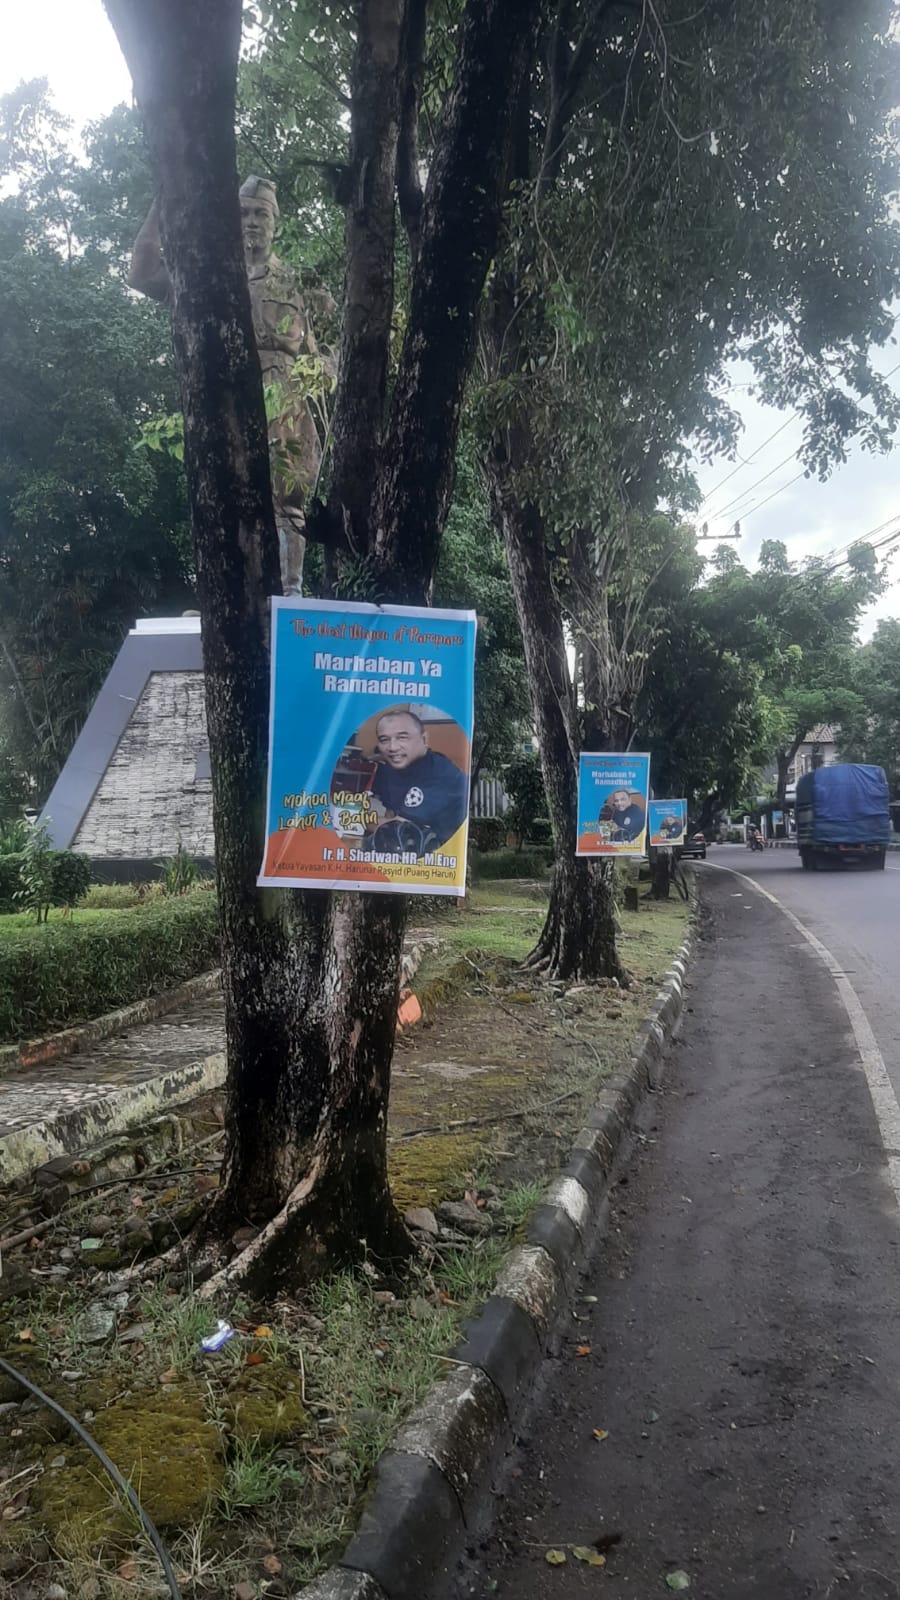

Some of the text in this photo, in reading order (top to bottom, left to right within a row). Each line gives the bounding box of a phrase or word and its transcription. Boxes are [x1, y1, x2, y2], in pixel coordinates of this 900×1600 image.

[290, 618, 314, 639] The
[314, 652, 442, 677] Marhaban Ya
[324, 674, 431, 698] Ramadhan
[283, 790, 371, 809] Mohon Maaf
[321, 810, 331, 826] &
[338, 809, 378, 830] Batin
[323, 847, 334, 860] Ir.
[336, 848, 347, 861] H.
[349, 848, 399, 864] Shafwan
[378, 866, 402, 877] Rasyid
[404, 867, 430, 879] (Puang
[431, 870, 457, 880] Harun)
